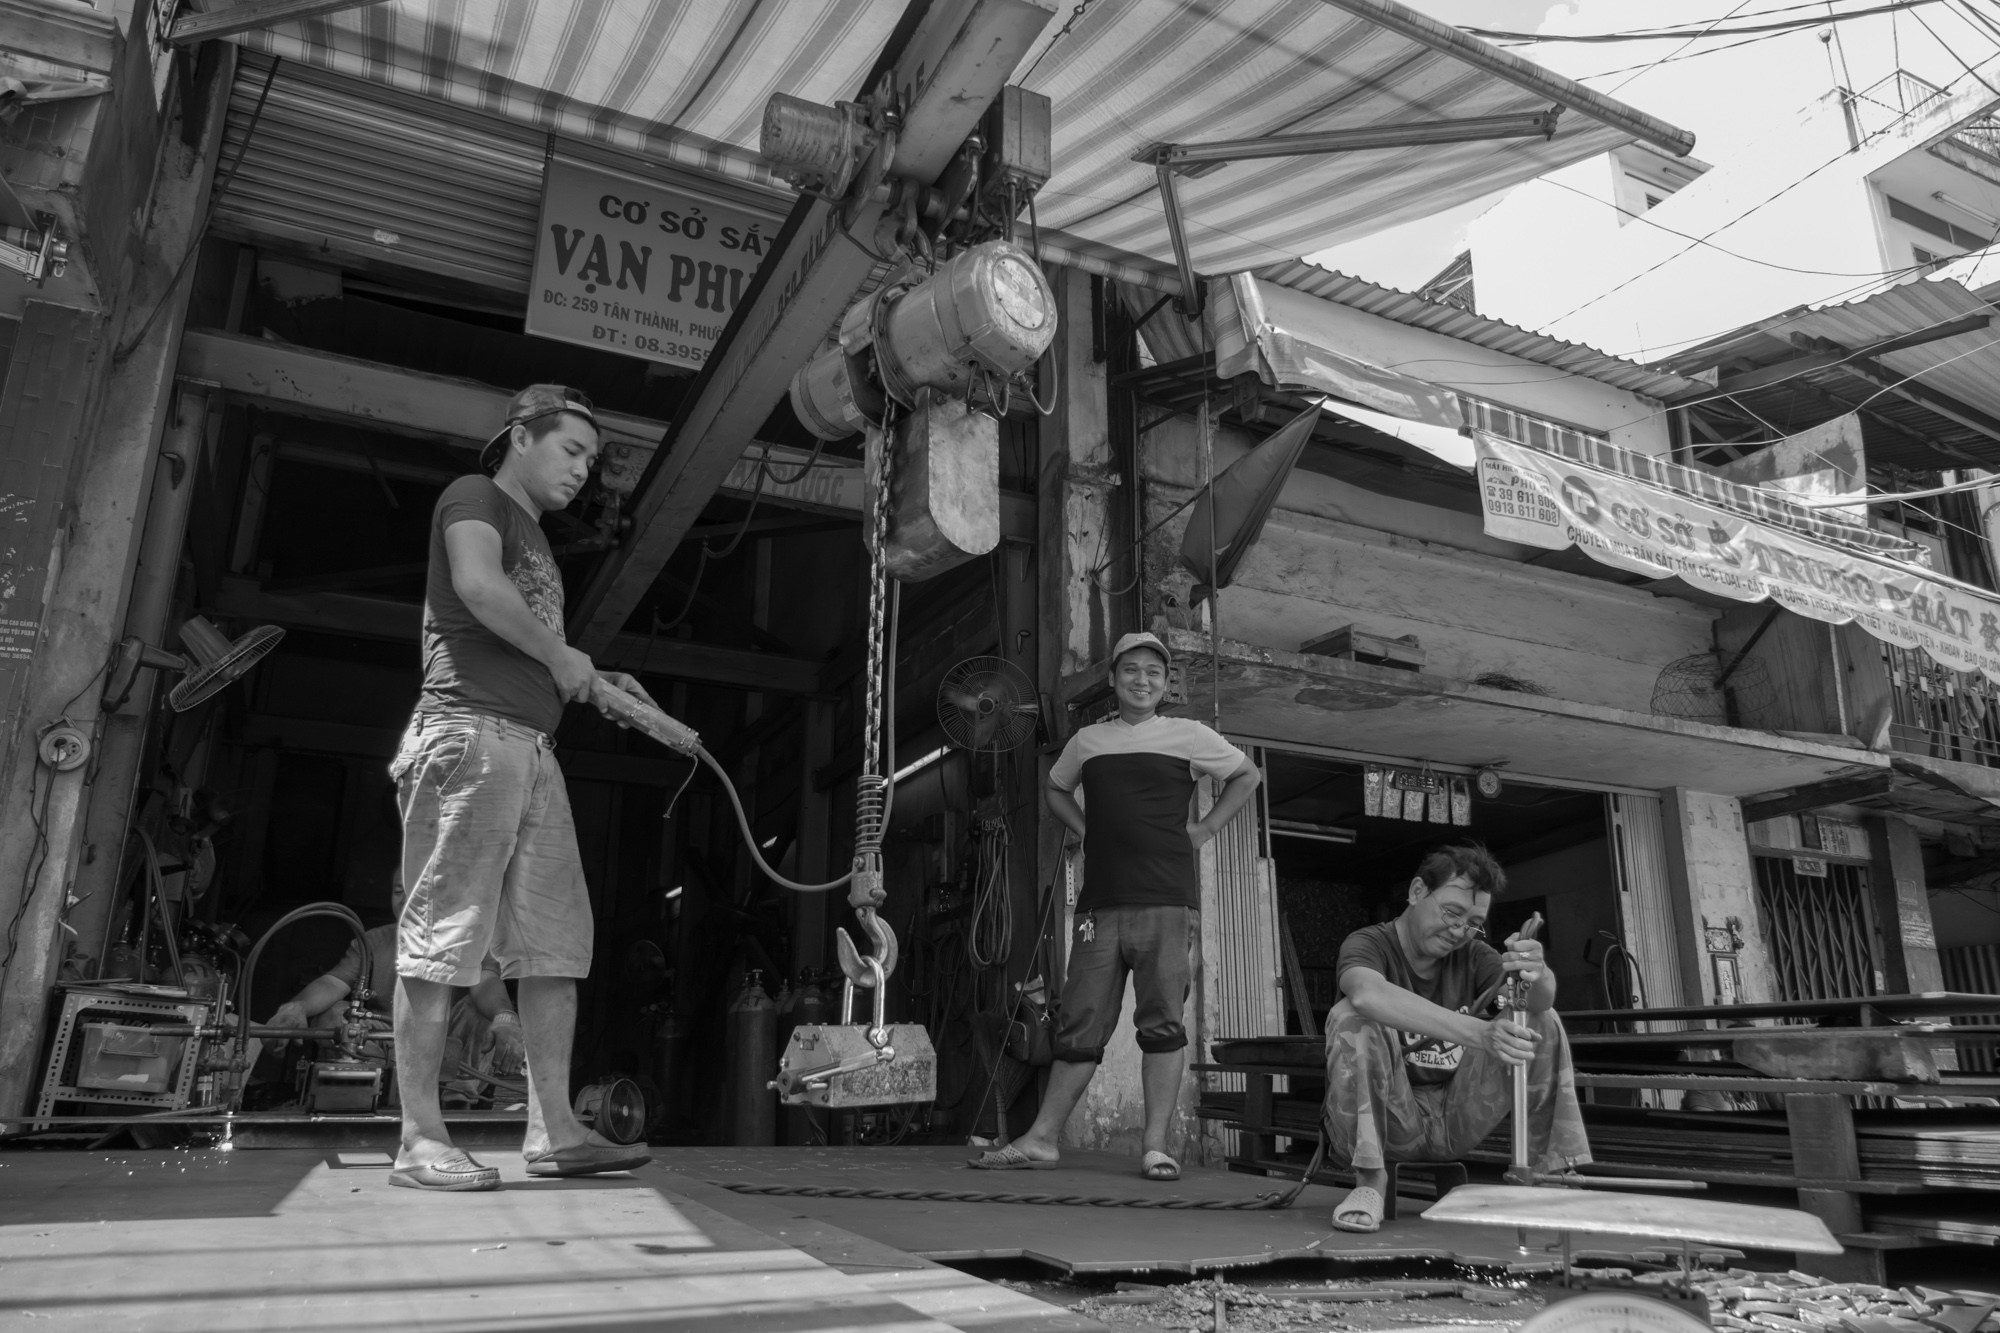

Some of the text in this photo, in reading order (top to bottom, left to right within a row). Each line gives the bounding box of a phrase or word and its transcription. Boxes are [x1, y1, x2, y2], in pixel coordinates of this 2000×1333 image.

[599, 194, 650, 225] CƠ
[658, 207, 708, 240] SỞ
[550, 224, 653, 294] VẠN
[543, 289, 568, 308] ĐC:
[571, 295, 599, 314] 259
[602, 301, 631, 322] TÂN
[634, 309, 684, 337] THÀNH,
[1488, 499, 1557, 523] 0913 611 608
[1498, 487, 1557, 510] 39 611 608
[1611, 502, 1652, 539] CƠ
[1656, 512, 1696, 552] SỞ
